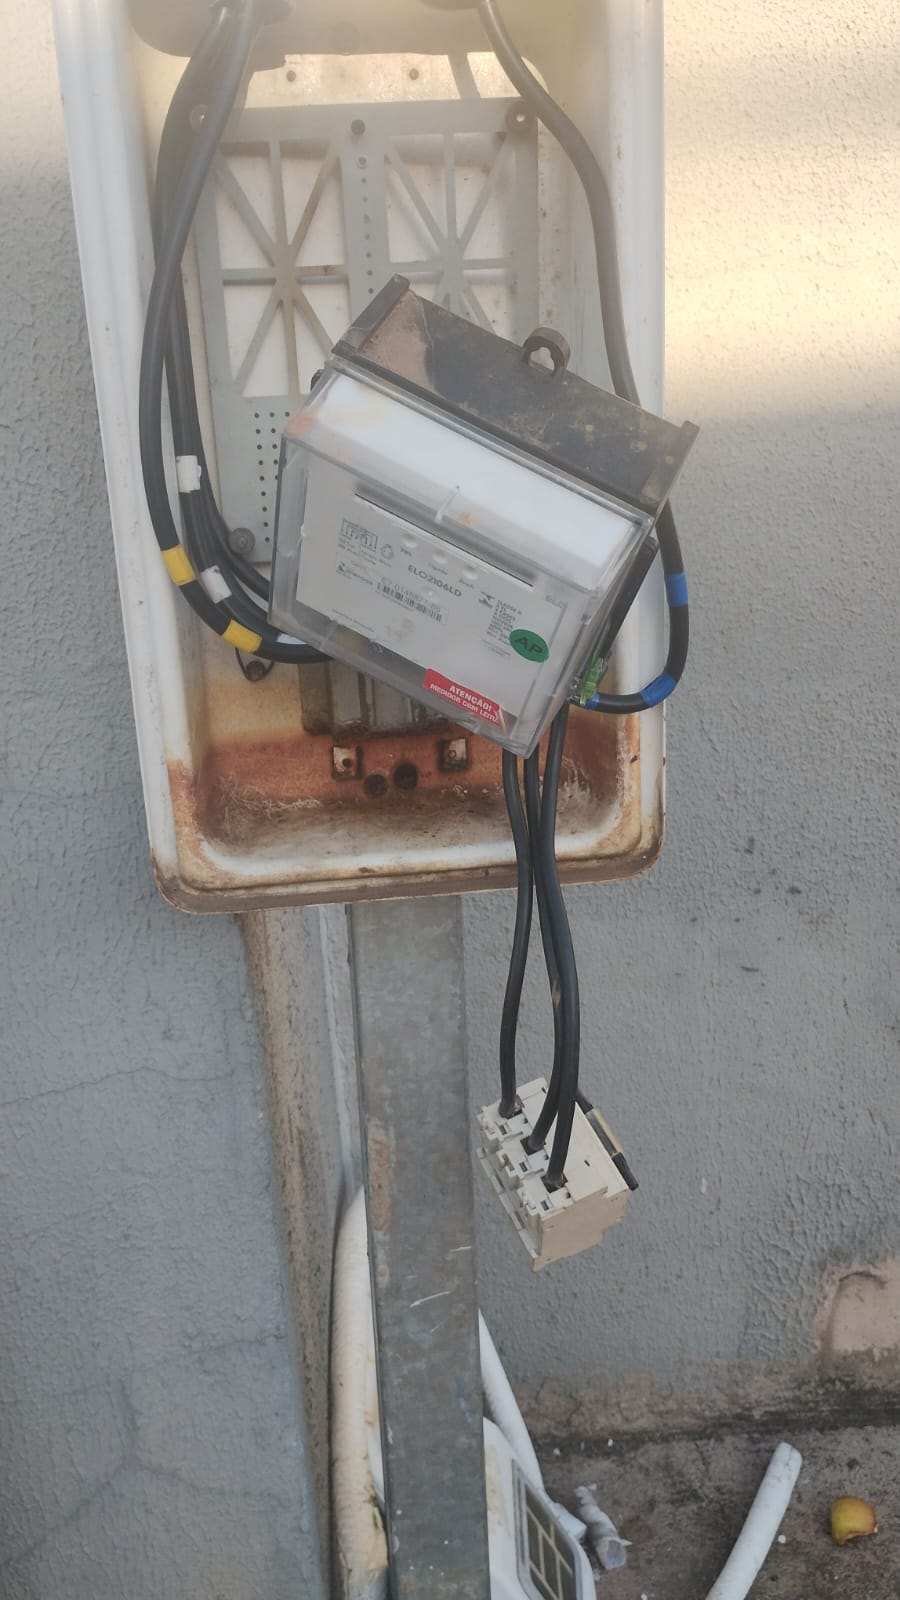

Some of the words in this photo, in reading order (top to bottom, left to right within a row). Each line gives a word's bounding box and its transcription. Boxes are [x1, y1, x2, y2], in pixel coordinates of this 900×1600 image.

[408, 564, 462, 597] ELO2106LD
[515, 637, 543, 653] AP
[430, 683, 461, 704] MEDIDOR
[462, 700, 479, 713] COM
